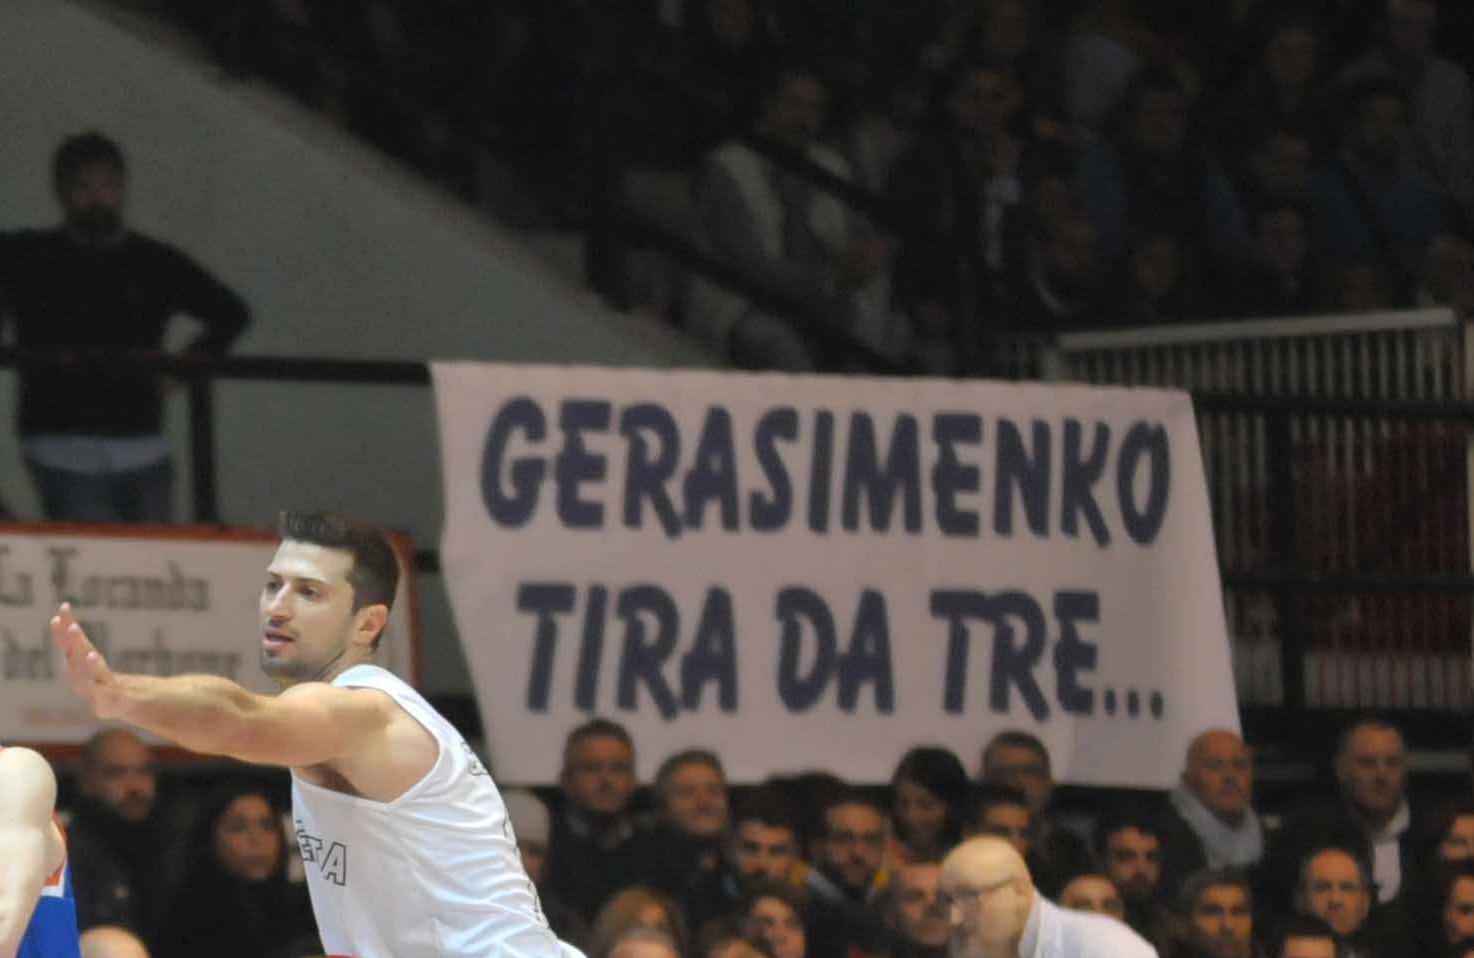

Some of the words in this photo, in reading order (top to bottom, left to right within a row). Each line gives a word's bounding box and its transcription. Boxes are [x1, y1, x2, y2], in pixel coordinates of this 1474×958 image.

[480, 396, 1172, 547] GERASIMENKO
[517, 583, 739, 721] TIRA
[775, 587, 895, 715] DA
[931, 590, 1165, 723] TRE...
